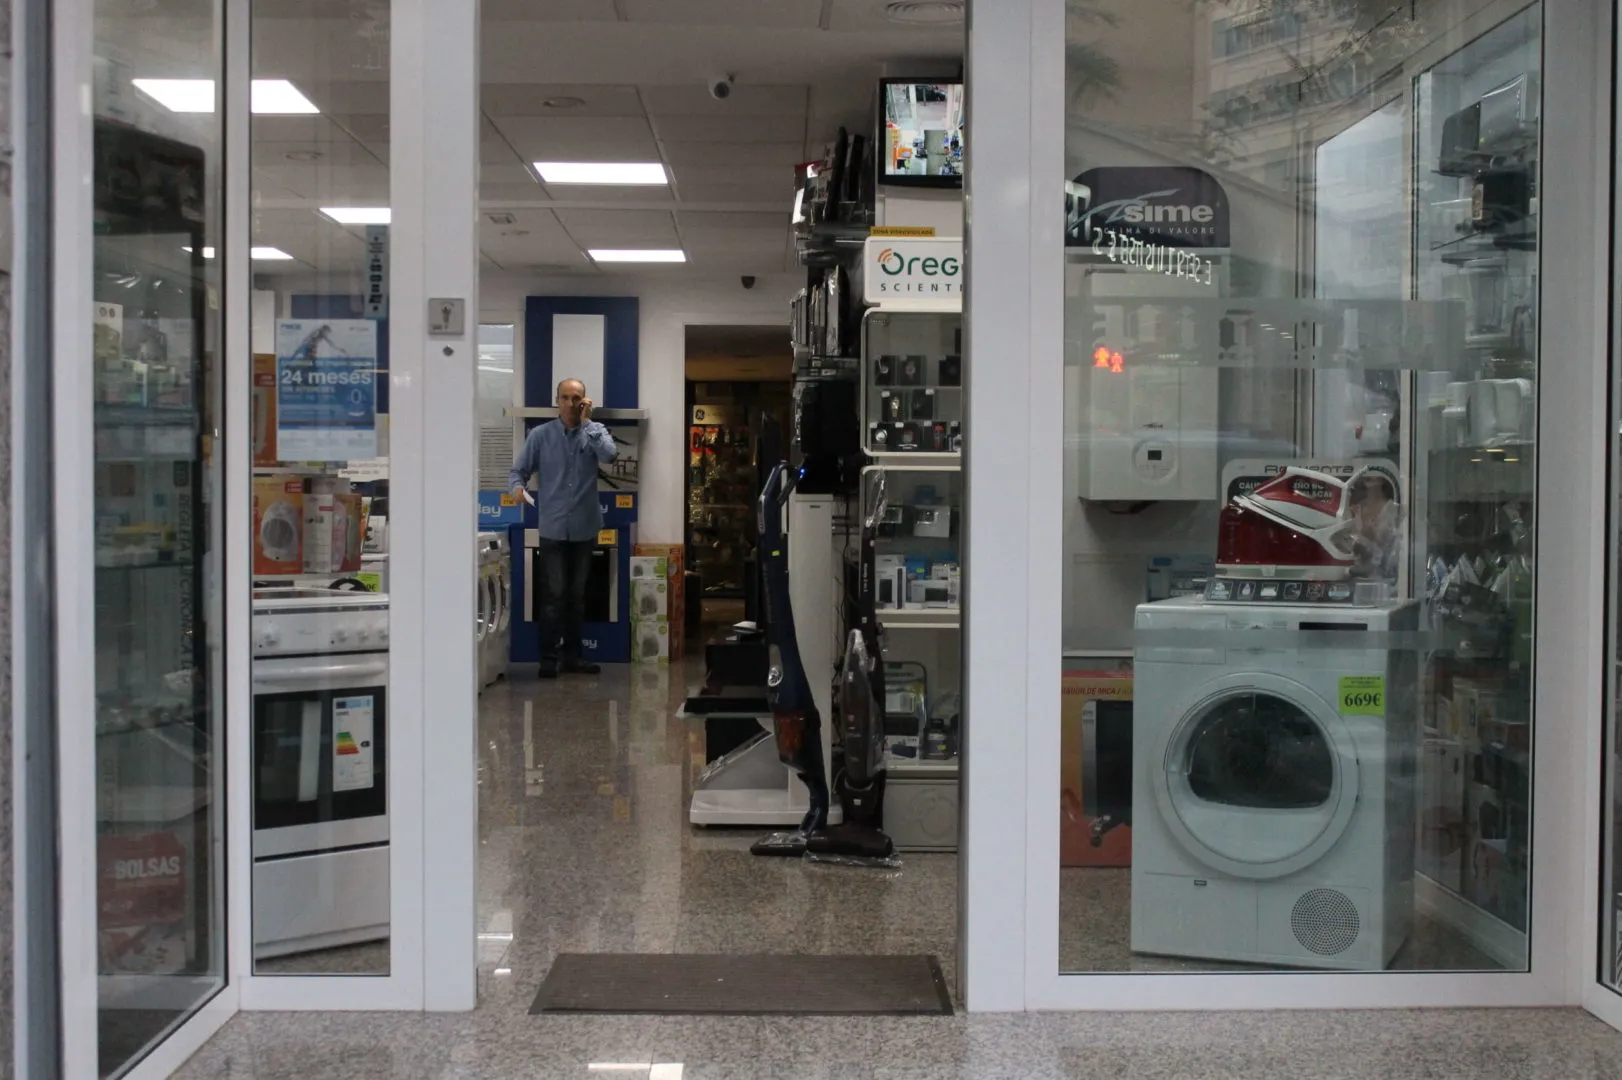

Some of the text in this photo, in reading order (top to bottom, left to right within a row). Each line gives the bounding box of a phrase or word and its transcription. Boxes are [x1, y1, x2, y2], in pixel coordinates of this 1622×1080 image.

[1123, 204, 1214, 223] sime
[280, 369, 372, 385] 24 meses
[1344, 692, 1382, 708] 669€
[114, 856, 180, 880] BOLSAS
